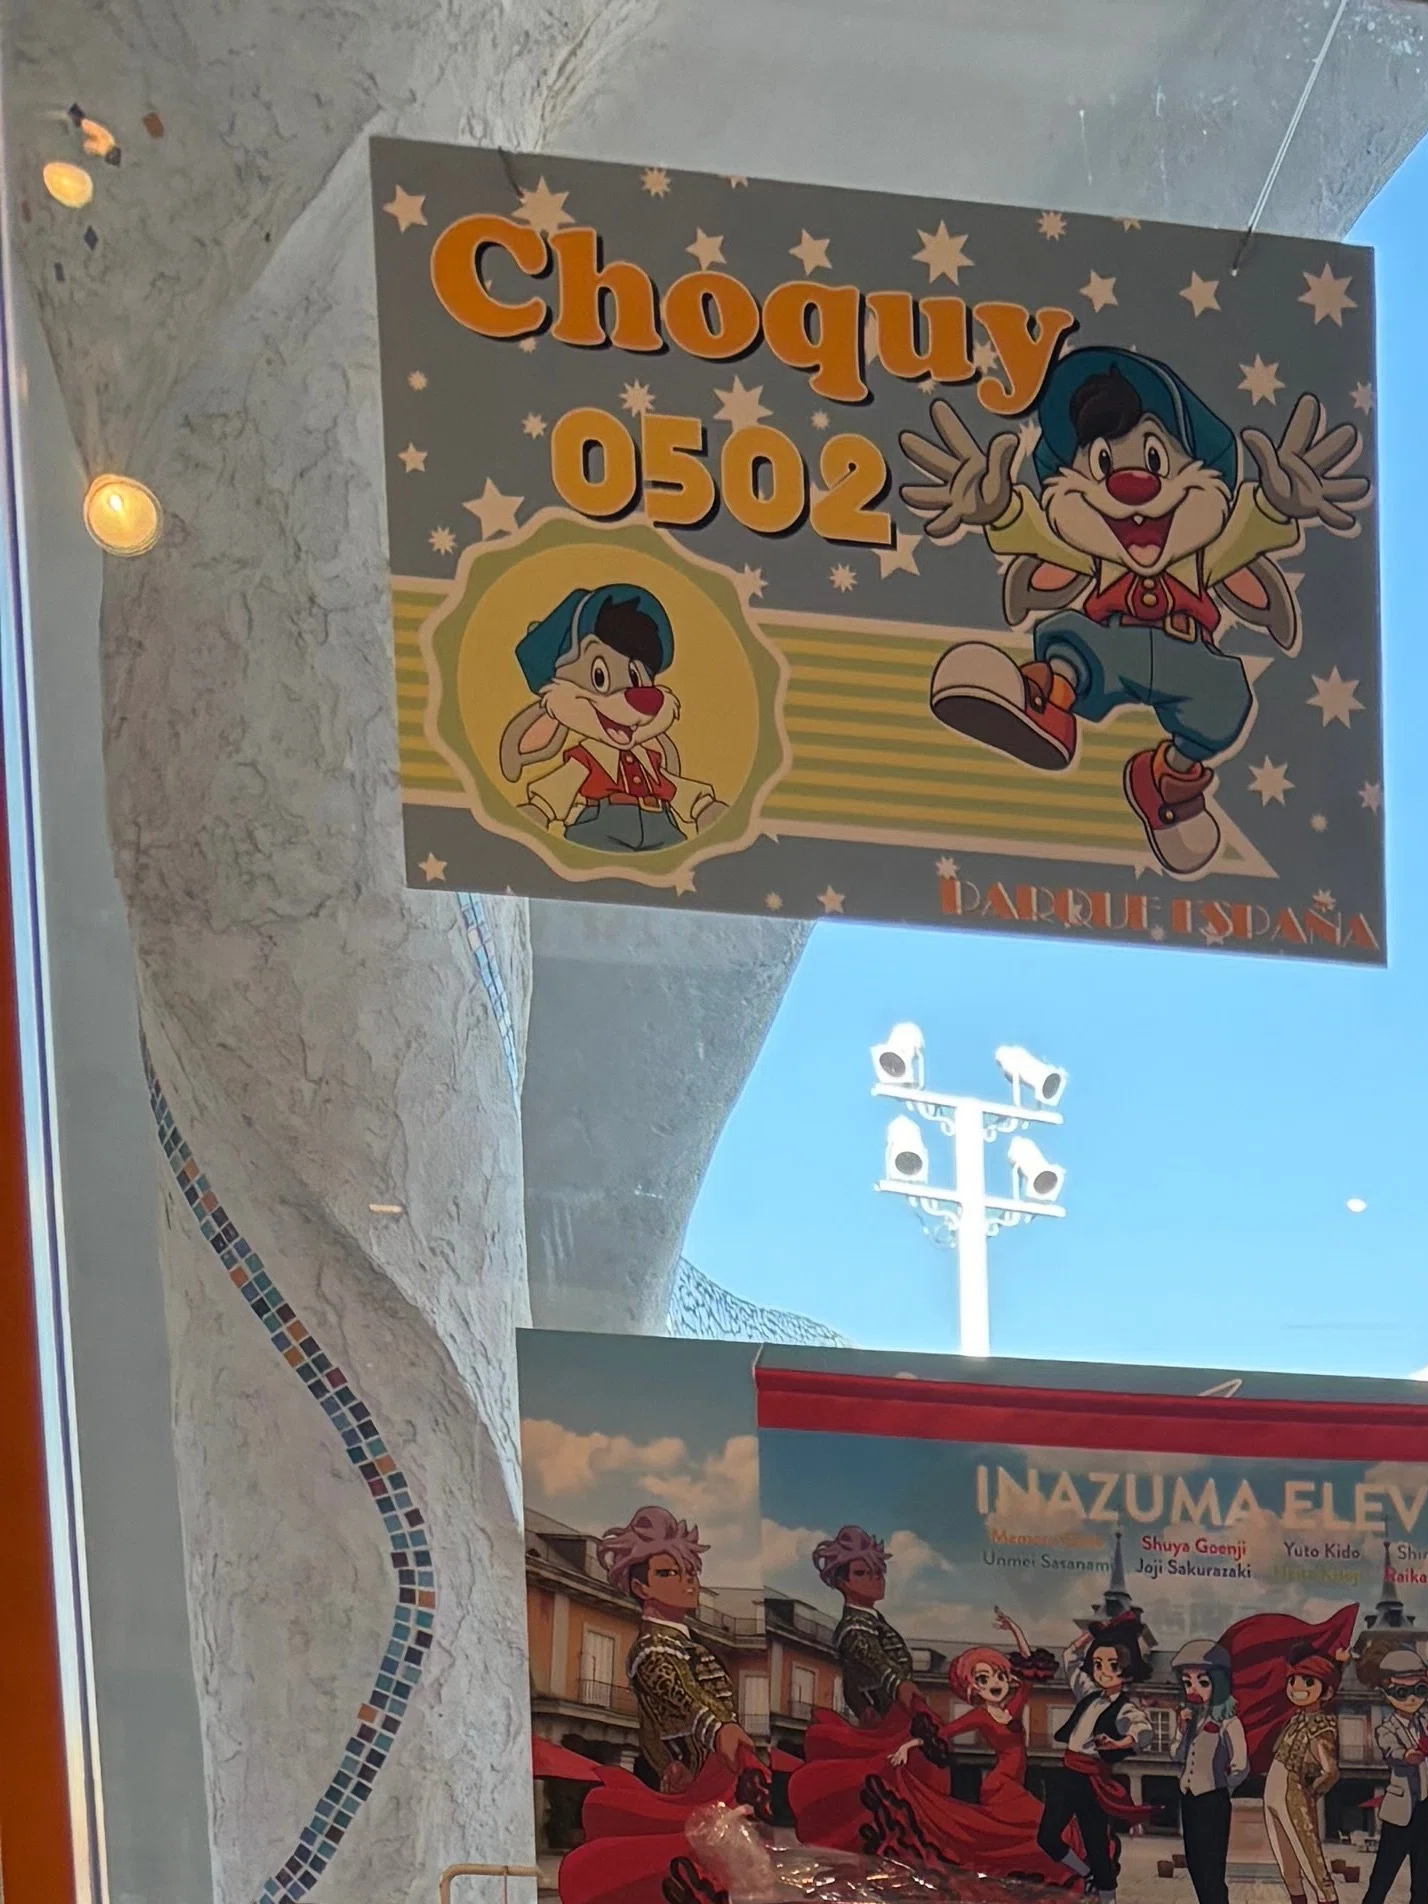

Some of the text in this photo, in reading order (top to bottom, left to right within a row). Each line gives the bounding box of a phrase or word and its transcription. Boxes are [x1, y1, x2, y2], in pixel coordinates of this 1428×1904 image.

[432, 213, 1077, 415] Choquy
[550, 408, 897, 548] 0502
[938, 874, 1381, 951] PARQUE ESPAÑA
[976, 1465, 1262, 1528] INAZUMA
[1142, 1535, 1190, 1557] Shuya
[1284, 1541, 1361, 1560] Yuto Kido
[983, 1549, 1036, 1567] Unmei
[1135, 1558, 1163, 1580] Joji
[1168, 1560, 1252, 1580] Sakurazaki
[1384, 1568, 1428, 1585] Raika
